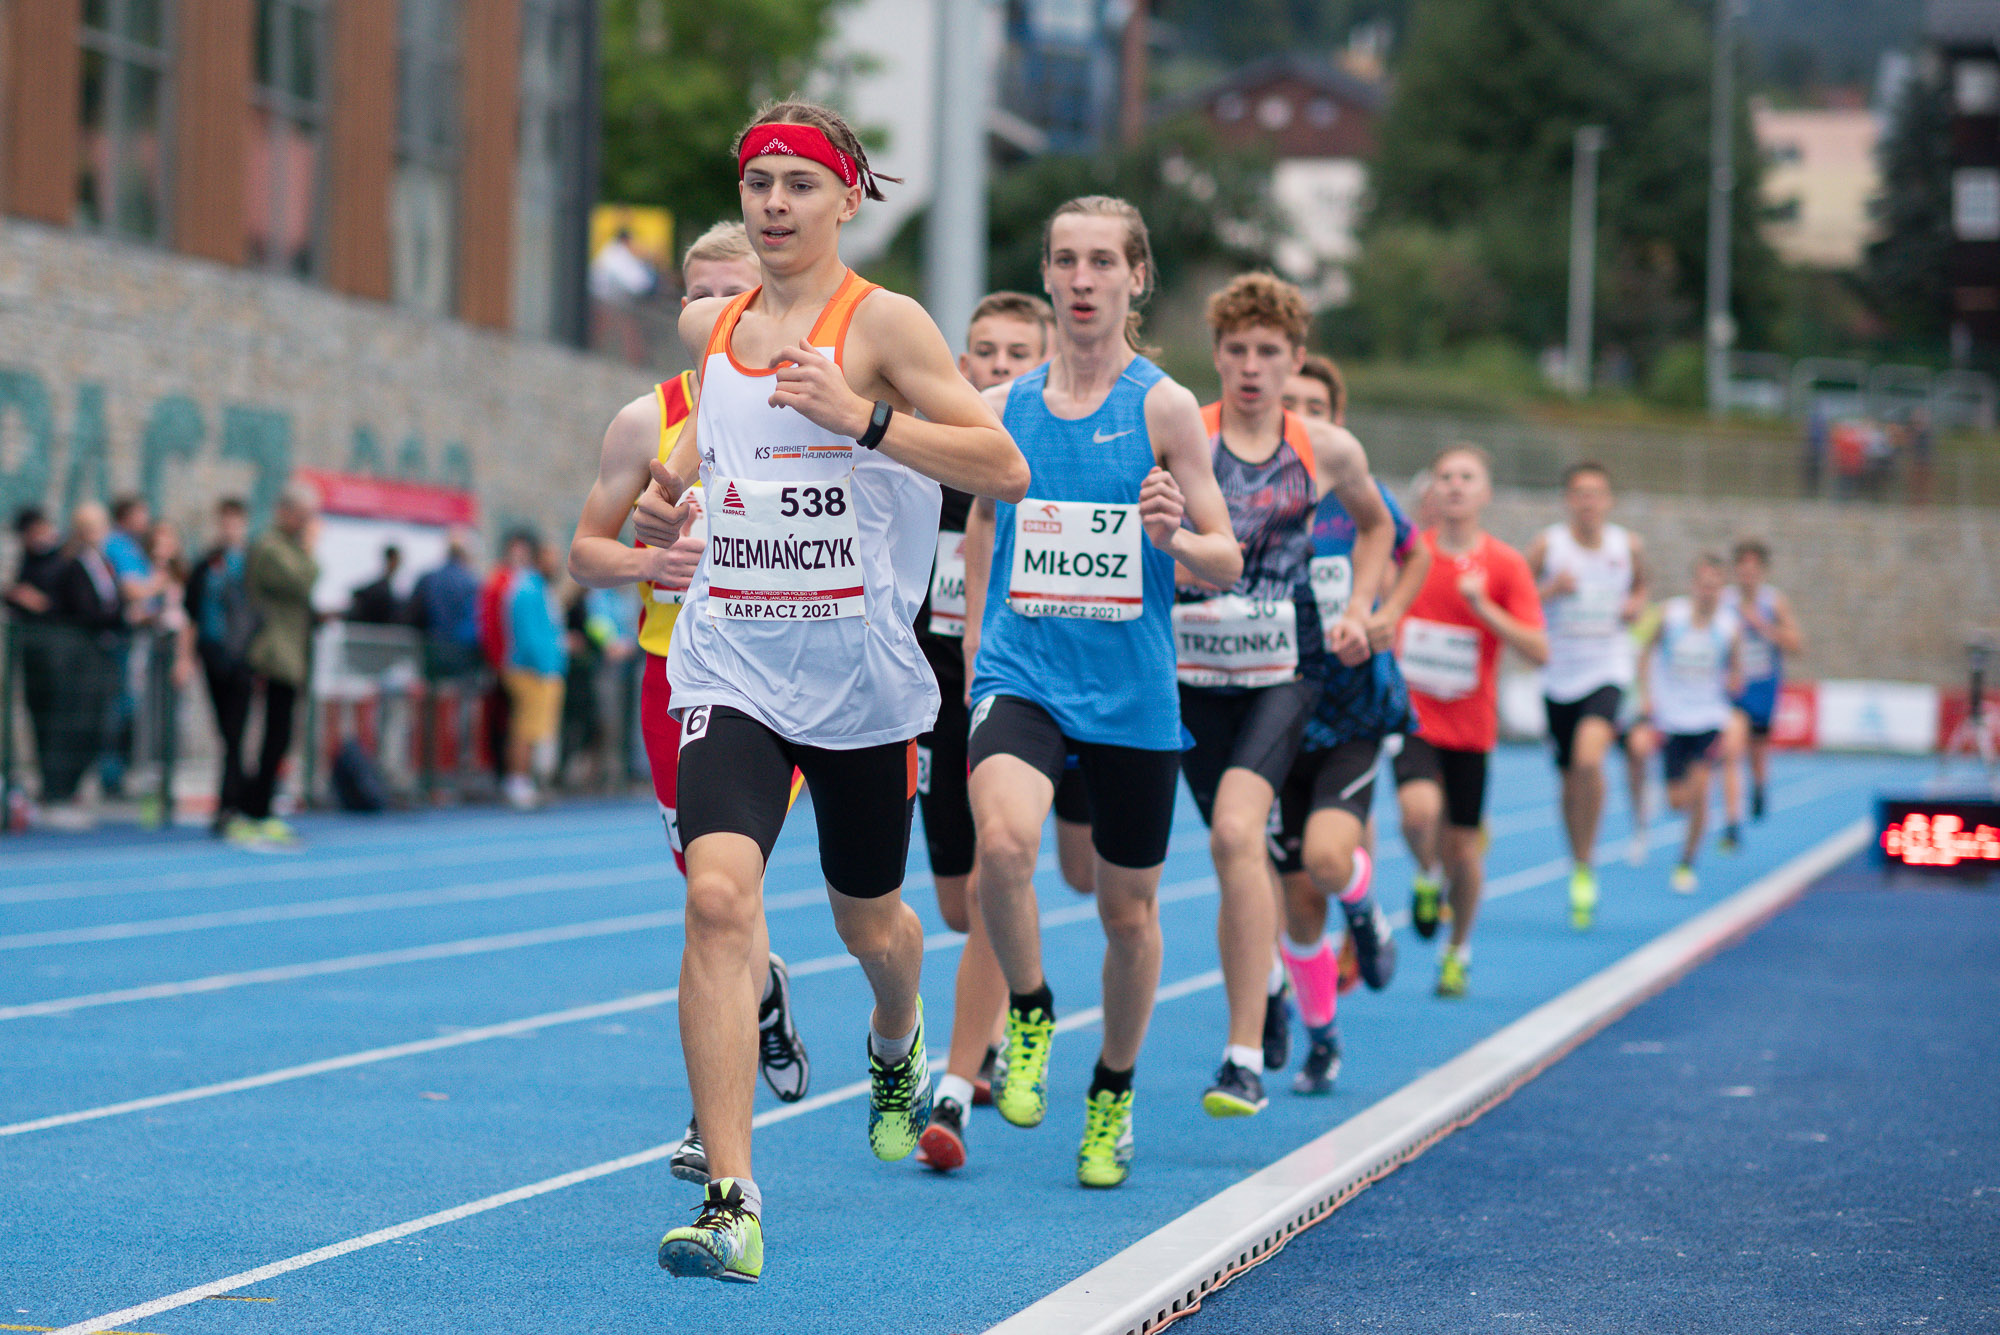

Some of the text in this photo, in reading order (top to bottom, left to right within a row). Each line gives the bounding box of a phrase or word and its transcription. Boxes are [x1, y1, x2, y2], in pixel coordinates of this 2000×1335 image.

[755, 445, 807, 460] KS PARKIET
[802, 451, 853, 459] HAJNÓWKA
[721, 508, 746, 516] KARPACZ
[780, 487, 847, 517] 538
[1091, 510, 1127, 534] 57
[713, 534, 856, 570] DZIEMIAŃCZYK
[1024, 549, 1128, 578] MIŁOSZ
[725, 602, 839, 618] KARPACZ 2021
[1024, 603, 1121, 619] KARPACZ 2021
[1179, 631, 1290, 655] TRZCINKA
[686, 705, 709, 736] 6
